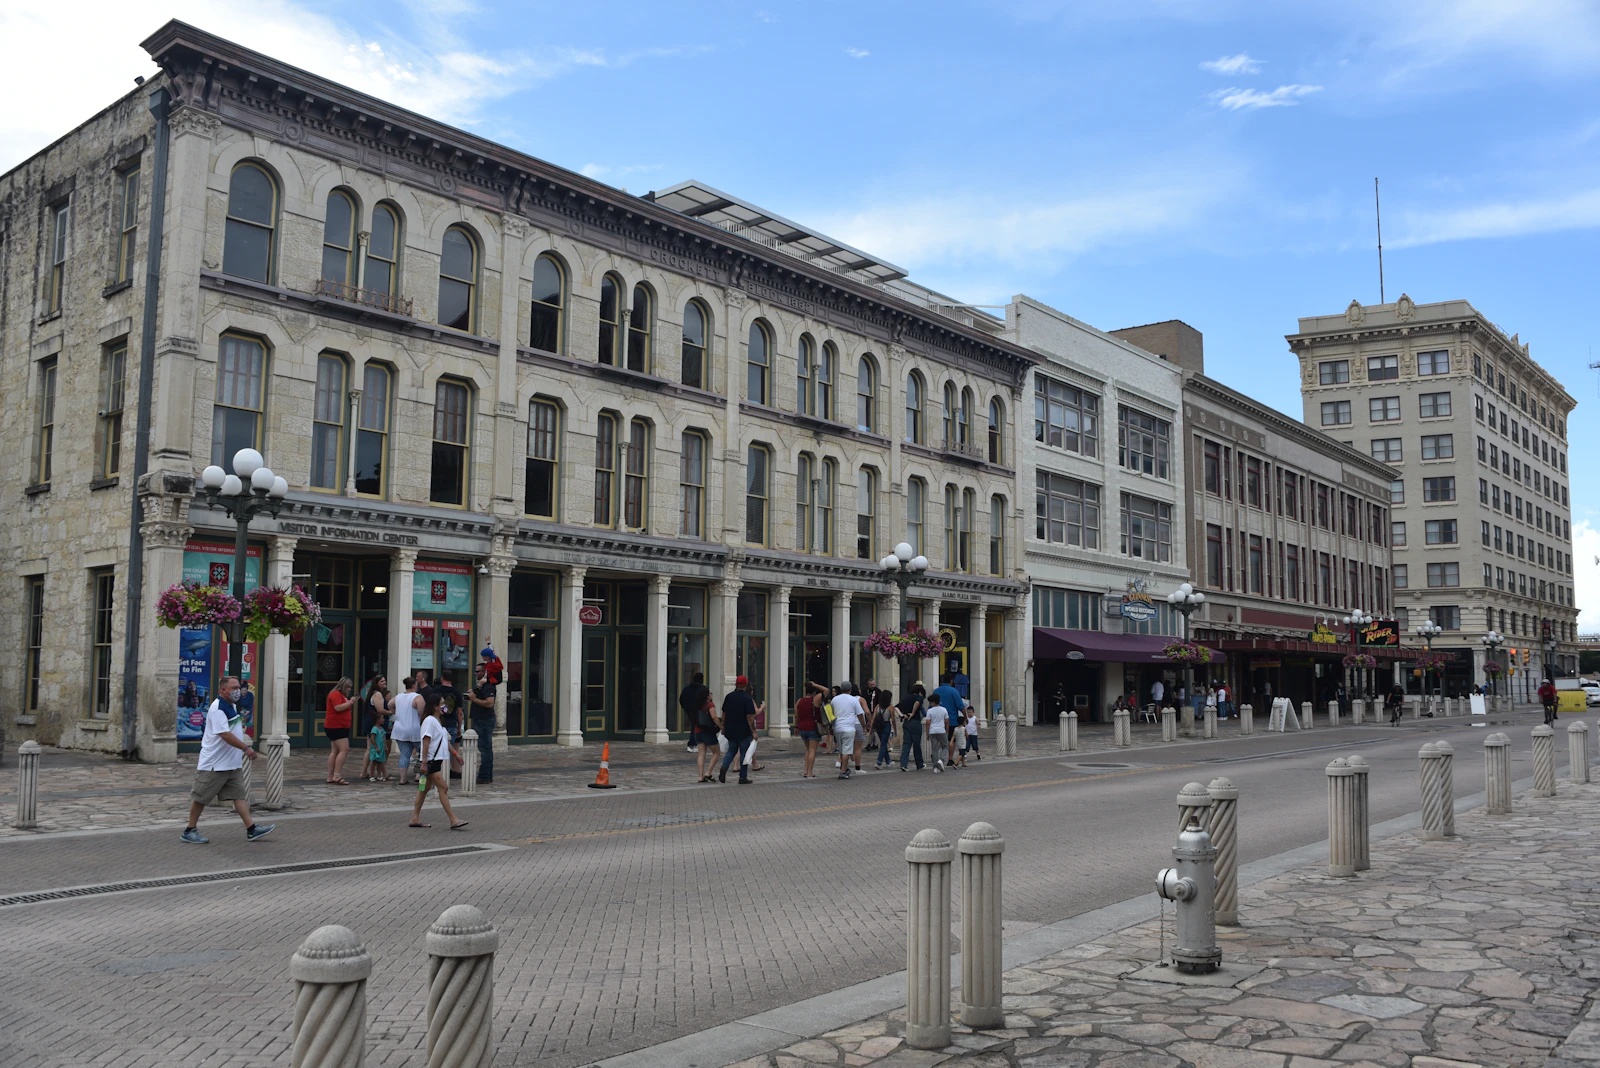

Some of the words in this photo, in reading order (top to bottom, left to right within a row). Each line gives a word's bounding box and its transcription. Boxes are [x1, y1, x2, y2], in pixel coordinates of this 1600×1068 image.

[280, 521, 317, 535] VISITOR
[321, 527, 379, 541] INFORMATION
[383, 532, 418, 545] CENTER
[807, 578, 817, 586] DEL
[942, 591, 956, 599] ALAMO
[427, 620, 434, 628] GO
[1366, 627, 1392, 643] RIDER
